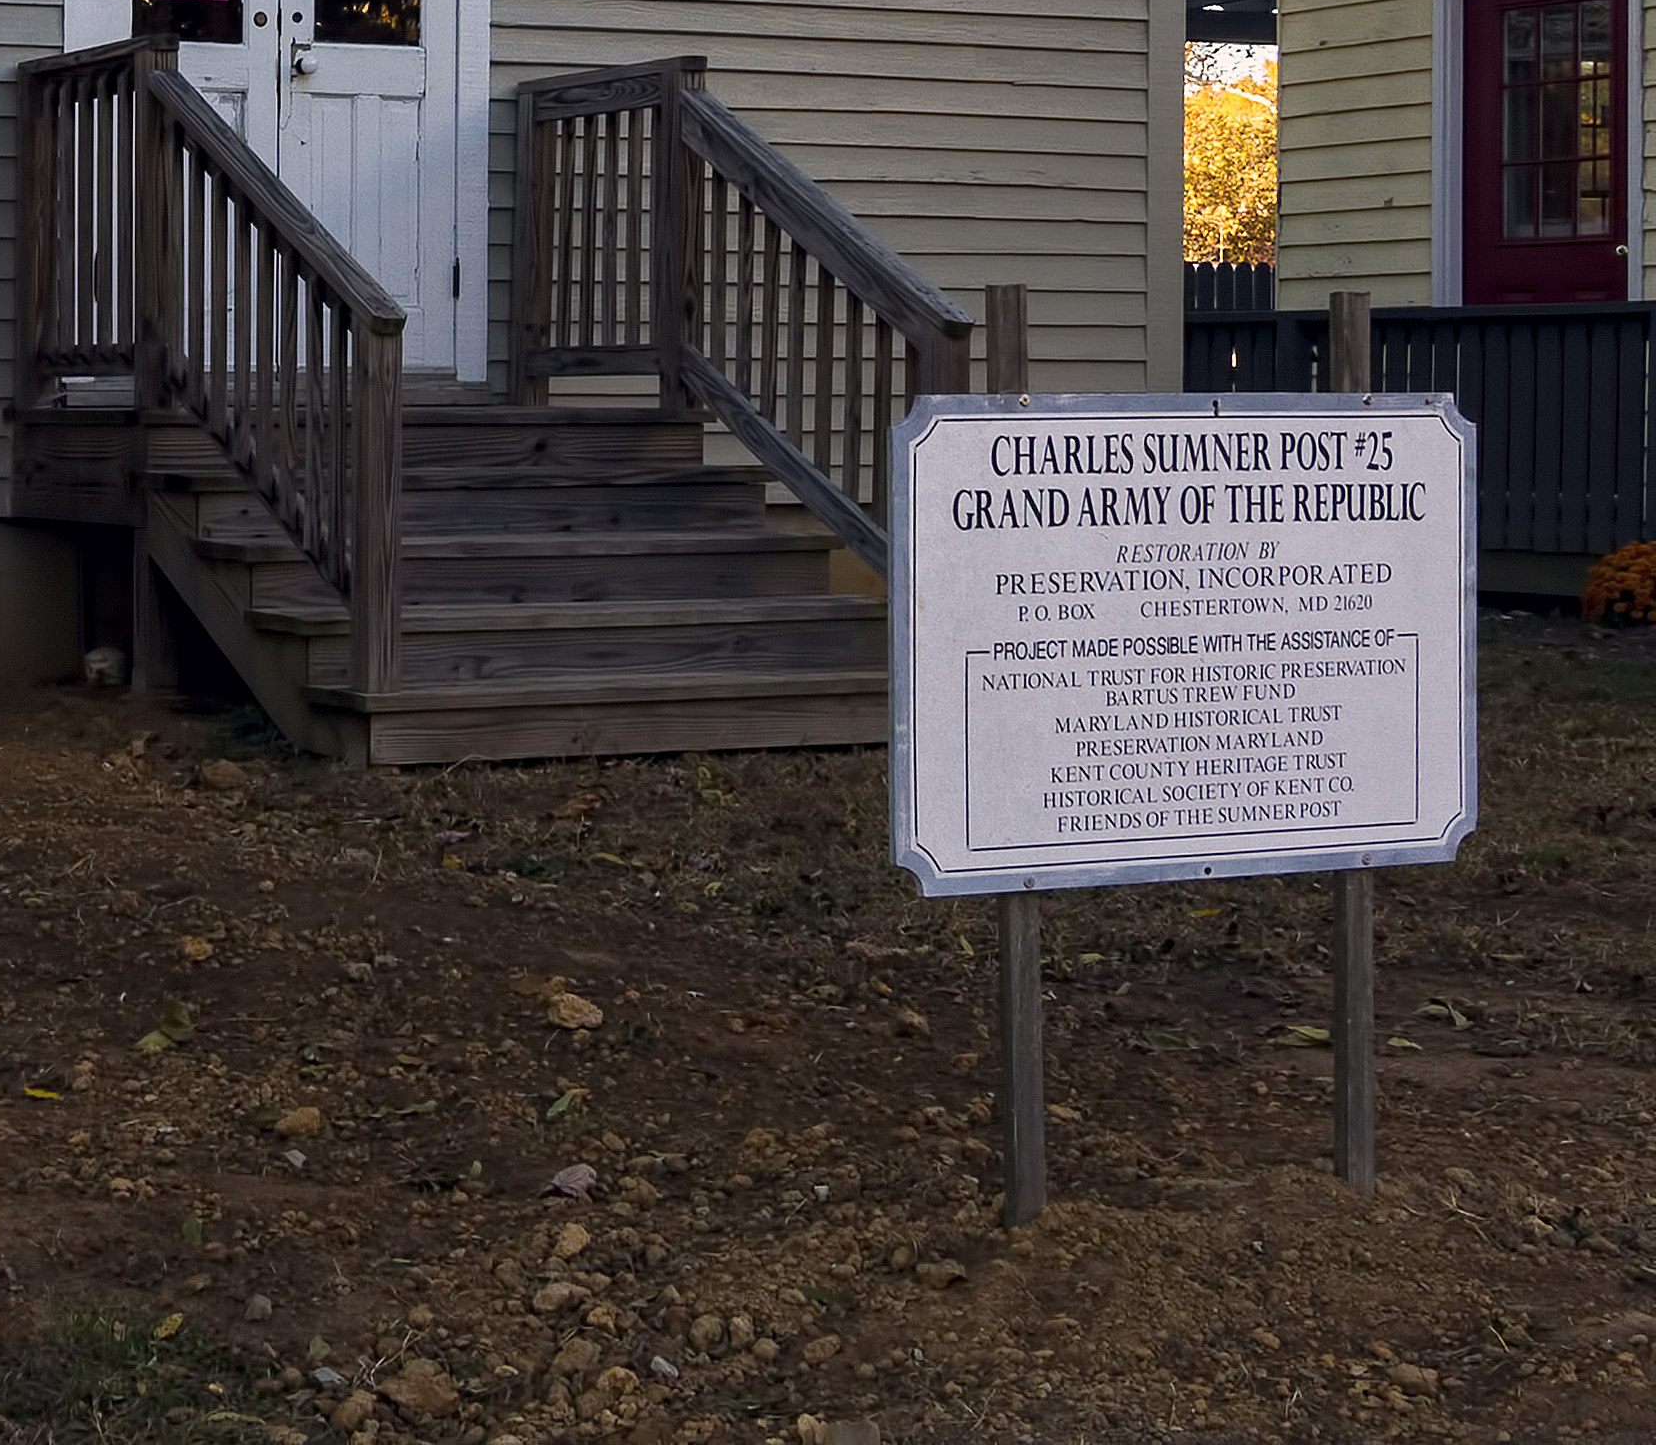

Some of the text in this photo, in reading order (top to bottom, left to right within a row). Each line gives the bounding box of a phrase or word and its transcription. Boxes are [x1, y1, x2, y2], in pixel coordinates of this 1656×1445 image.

[991, 431, 1393, 476] CHARLES SUMNER POST #25
[952, 482, 1427, 531] GRAND ARMY OF THE REPUBLIC
[1116, 541, 1280, 563] RESTORATION BY
[996, 563, 1392, 595] PRESERVATION, INCORPORATED
[1018, 594, 1373, 622] P. O. BOX CHESTERTOWN, MD 21620
[994, 628, 1394, 660] PROJECT MADE POSSIBLE WITH THE ASSISTANCE OF
[982, 658, 1406, 691] NATIONAL TRUST FOR HISTORIC PRESERVATION
[1106, 683, 1296, 707] BARTUS TREW FUND
[1055, 705, 1342, 734] MARYLAND HISTORICAL TRUST
[1076, 730, 1324, 757] PRESERVATION MARYLAND
[1051, 752, 1347, 783] KENT COUNTY HERITAGE TRUST
[1043, 775, 1355, 809] HISTORICAL SOCIETY OF KENT CO.
[1058, 800, 1342, 833] FRIENDS OF THE SUMNER POST
